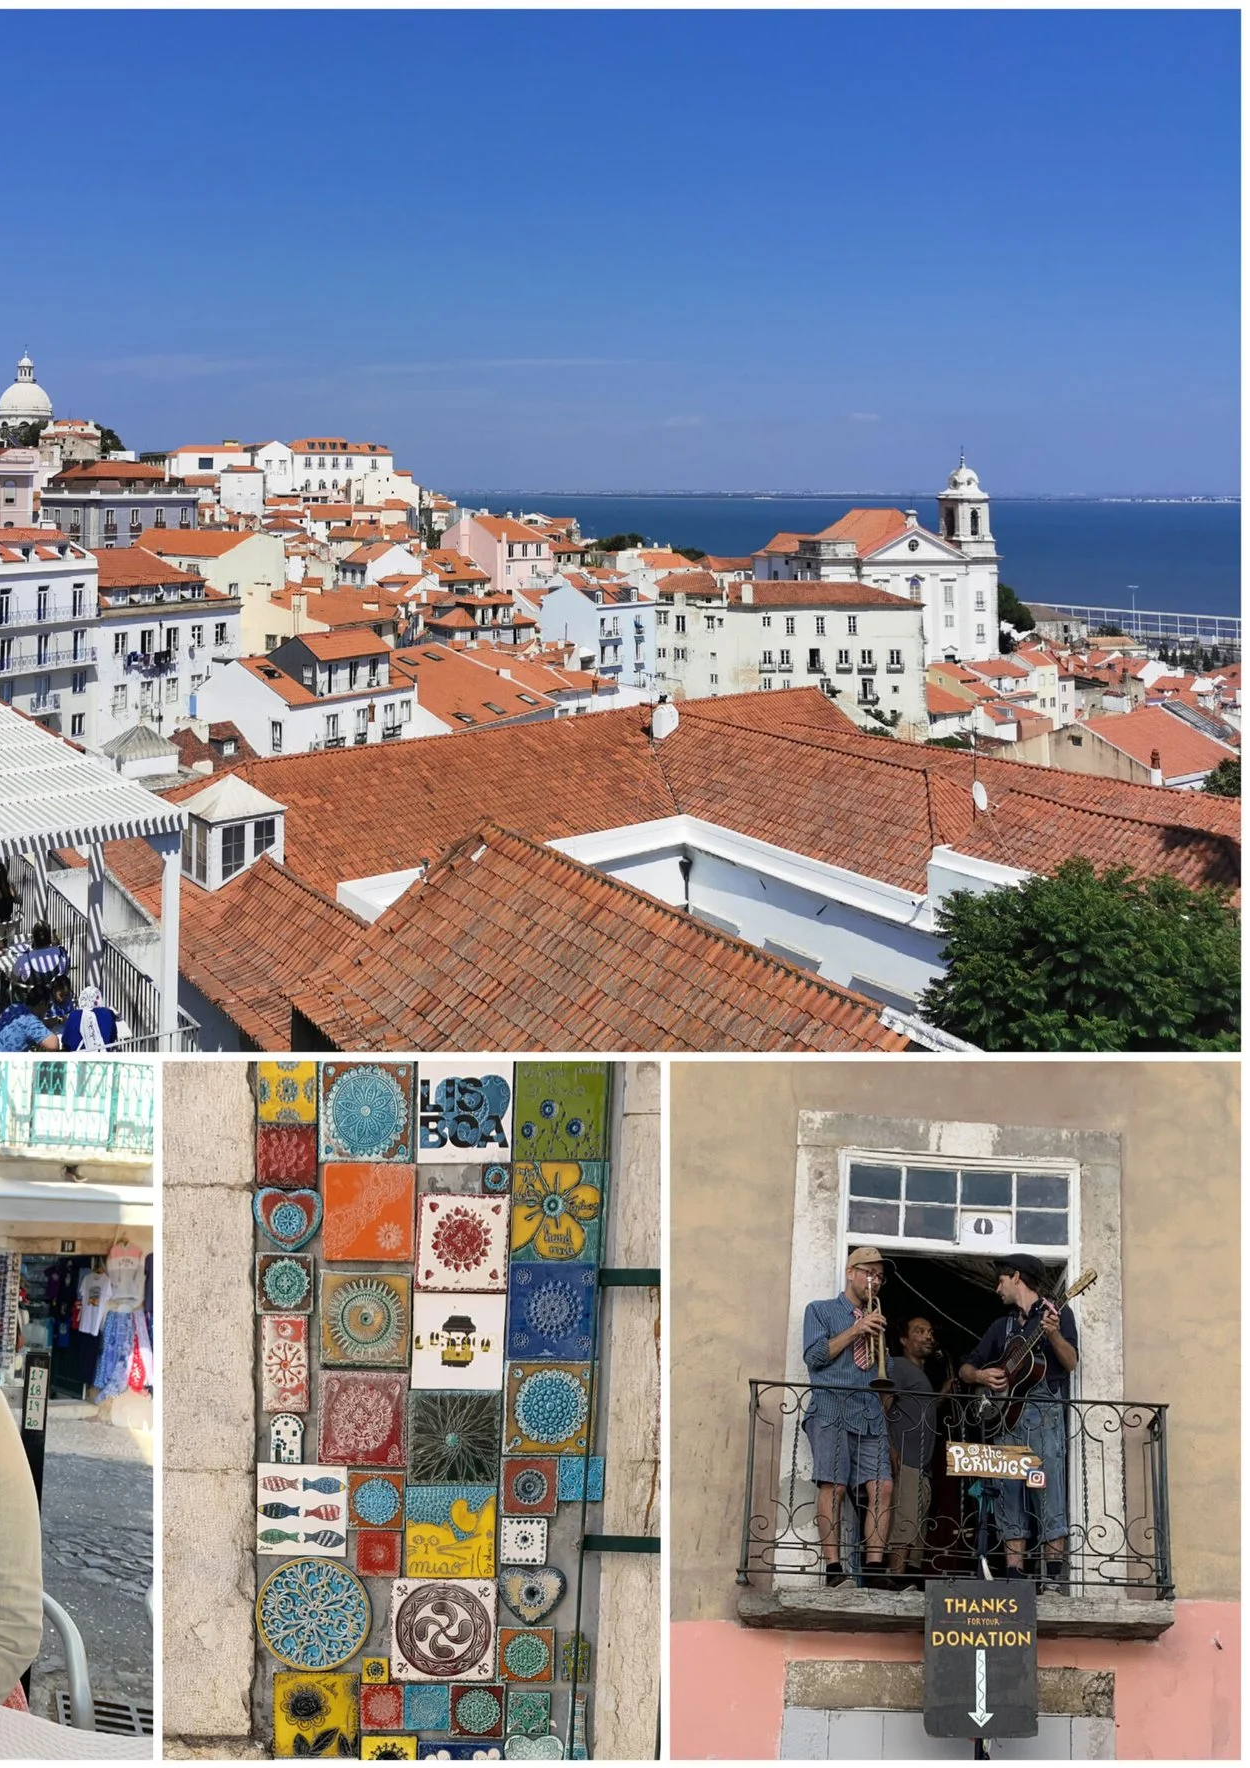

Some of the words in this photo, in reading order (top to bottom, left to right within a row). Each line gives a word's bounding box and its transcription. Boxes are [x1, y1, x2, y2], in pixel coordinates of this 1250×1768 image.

[420, 1077, 484, 1113] LIS
[420, 1114, 509, 1149] BOA
[31, 1369, 44, 1380] 17
[30, 1384, 41, 1396] 18
[28, 1400, 40, 1412] 19
[26, 1417, 39, 1427] 20
[944, 1597, 1019, 1614] THANKS
[967, 1617, 981, 1626] FOR
[981, 1617, 1000, 1626] YOUR
[931, 1630, 1032, 1647] DONATION
